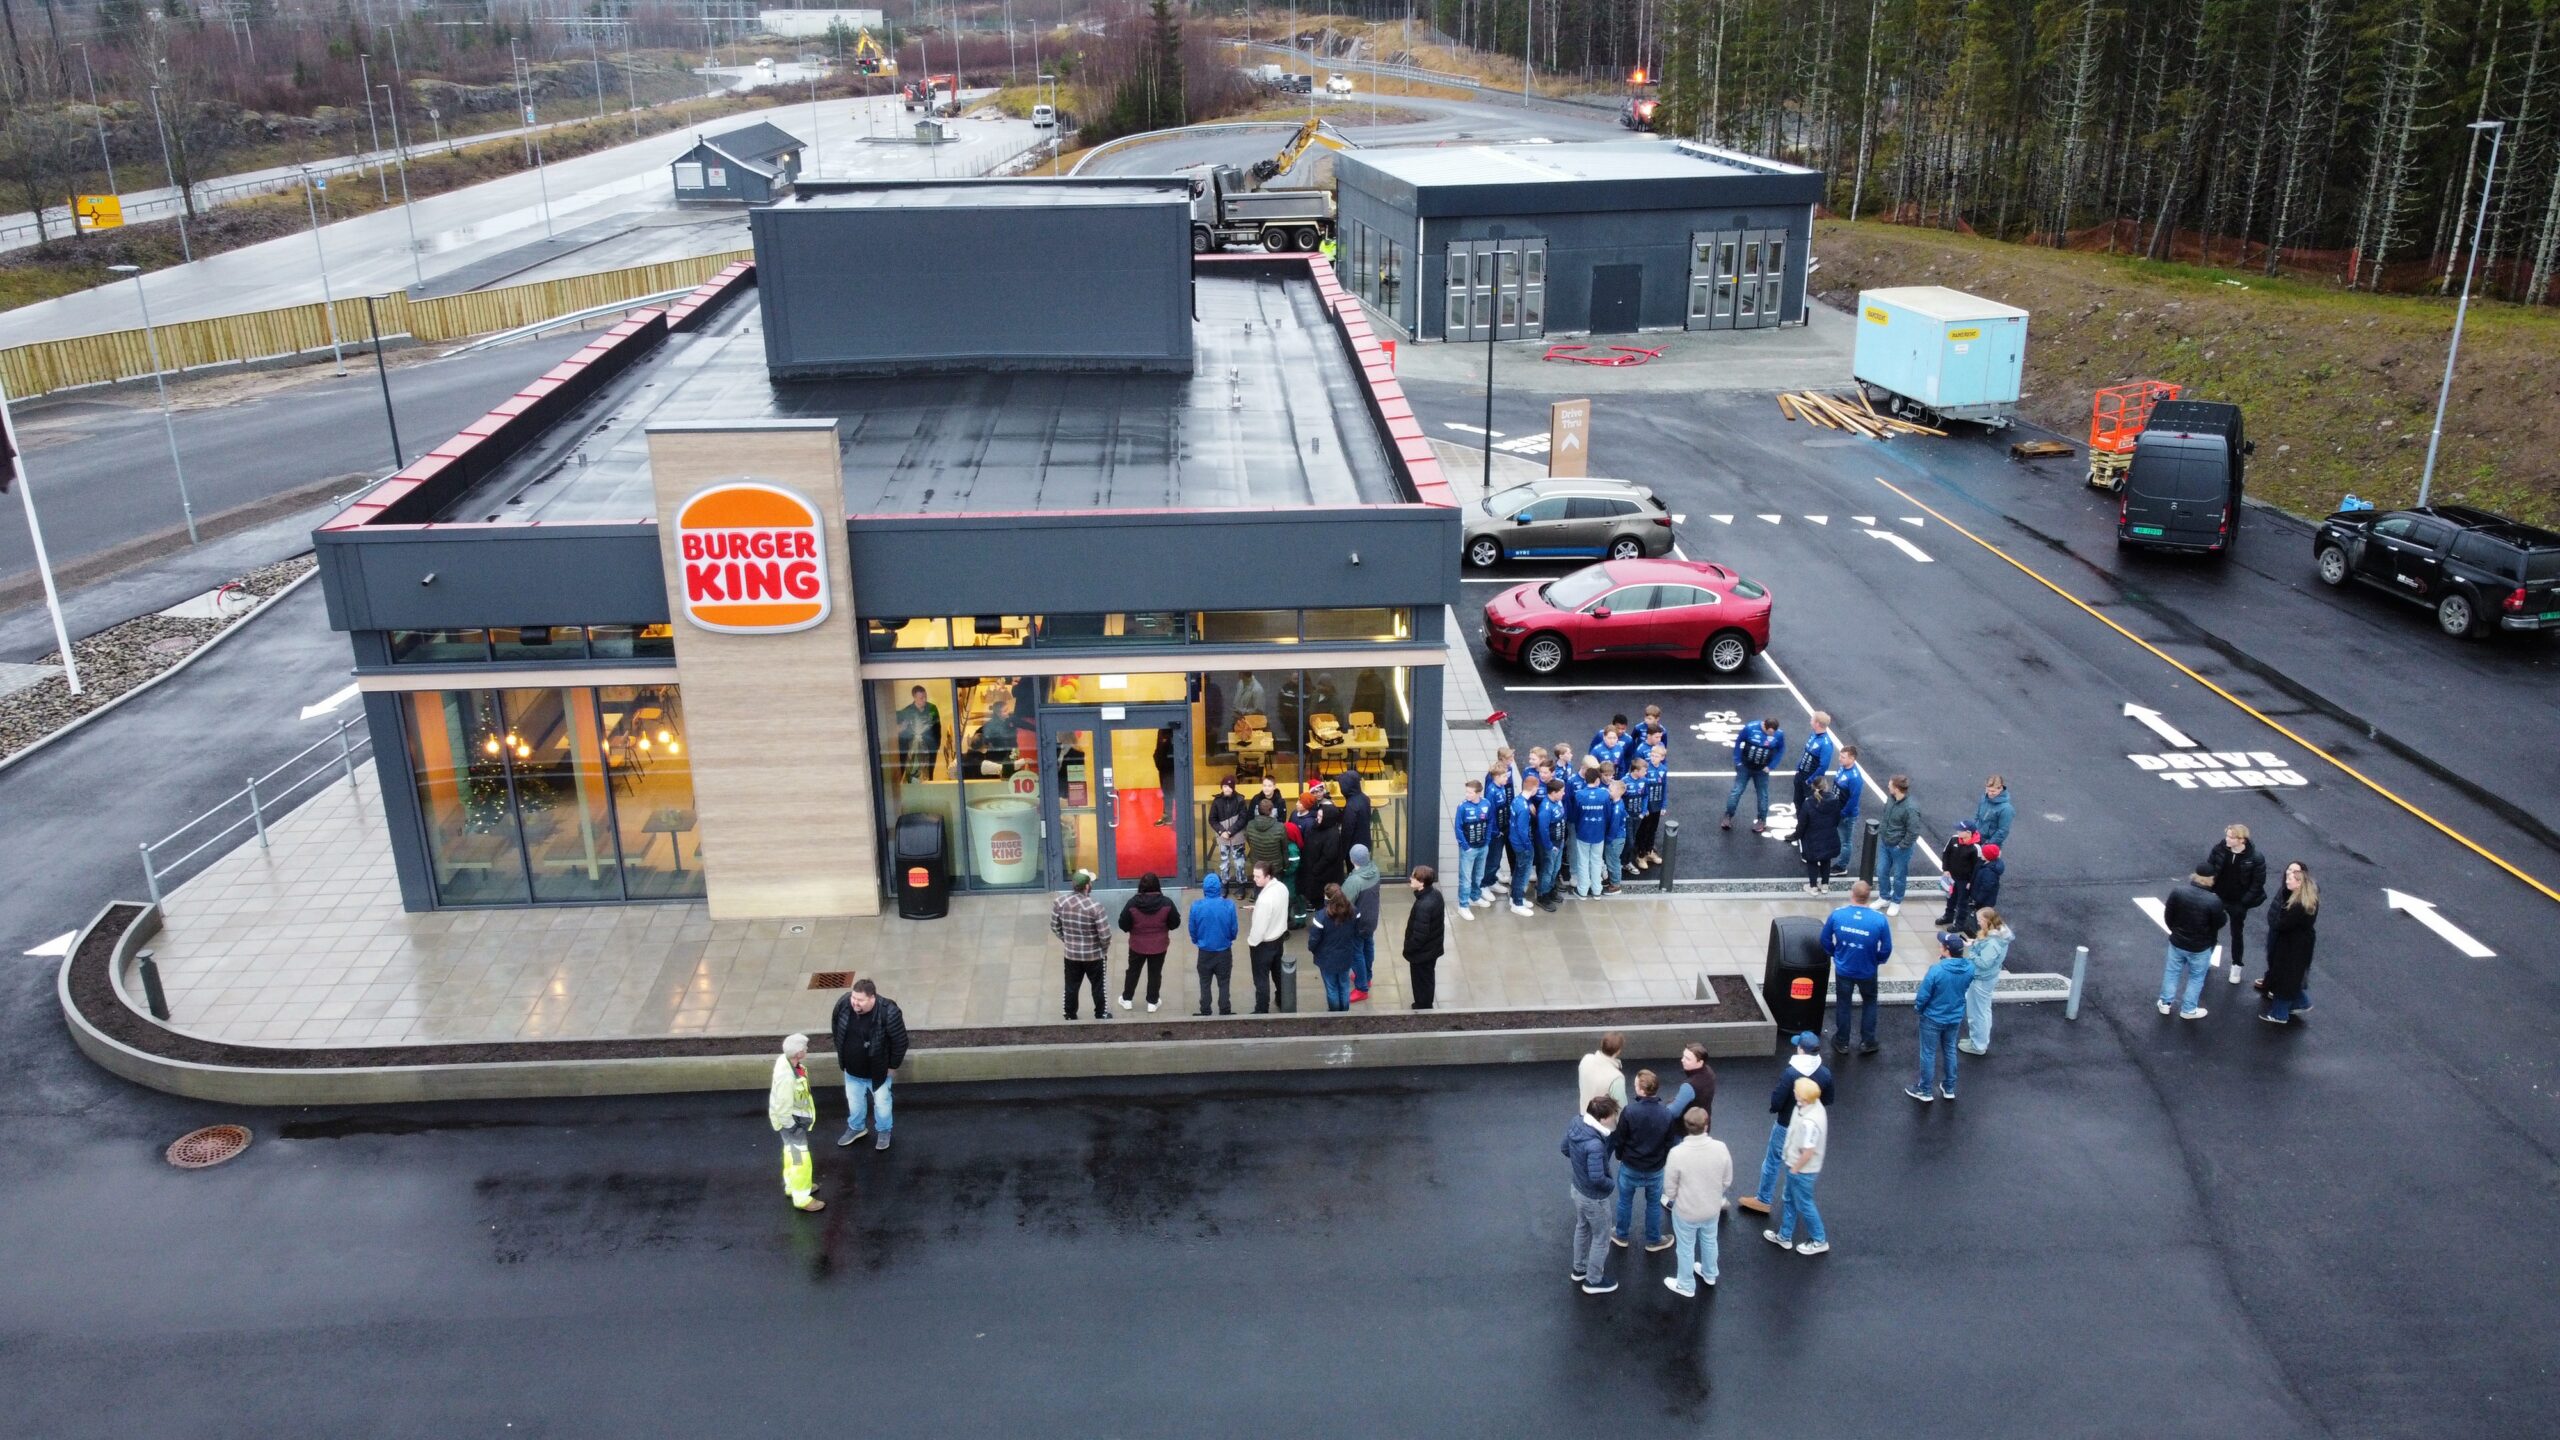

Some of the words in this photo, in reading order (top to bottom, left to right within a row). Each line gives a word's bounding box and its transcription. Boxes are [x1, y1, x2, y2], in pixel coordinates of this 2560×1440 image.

[1561, 409, 1584, 419] Drive
[1561, 419, 1582, 429] Thru
[681, 531, 817, 560] BURGER
[685, 560, 821, 602] KING
[2127, 752, 2289, 770] DRIVE
[2159, 769, 2309, 789] THRU
[991, 840, 1023, 849] BURGER
[991, 848, 1023, 860] KING
